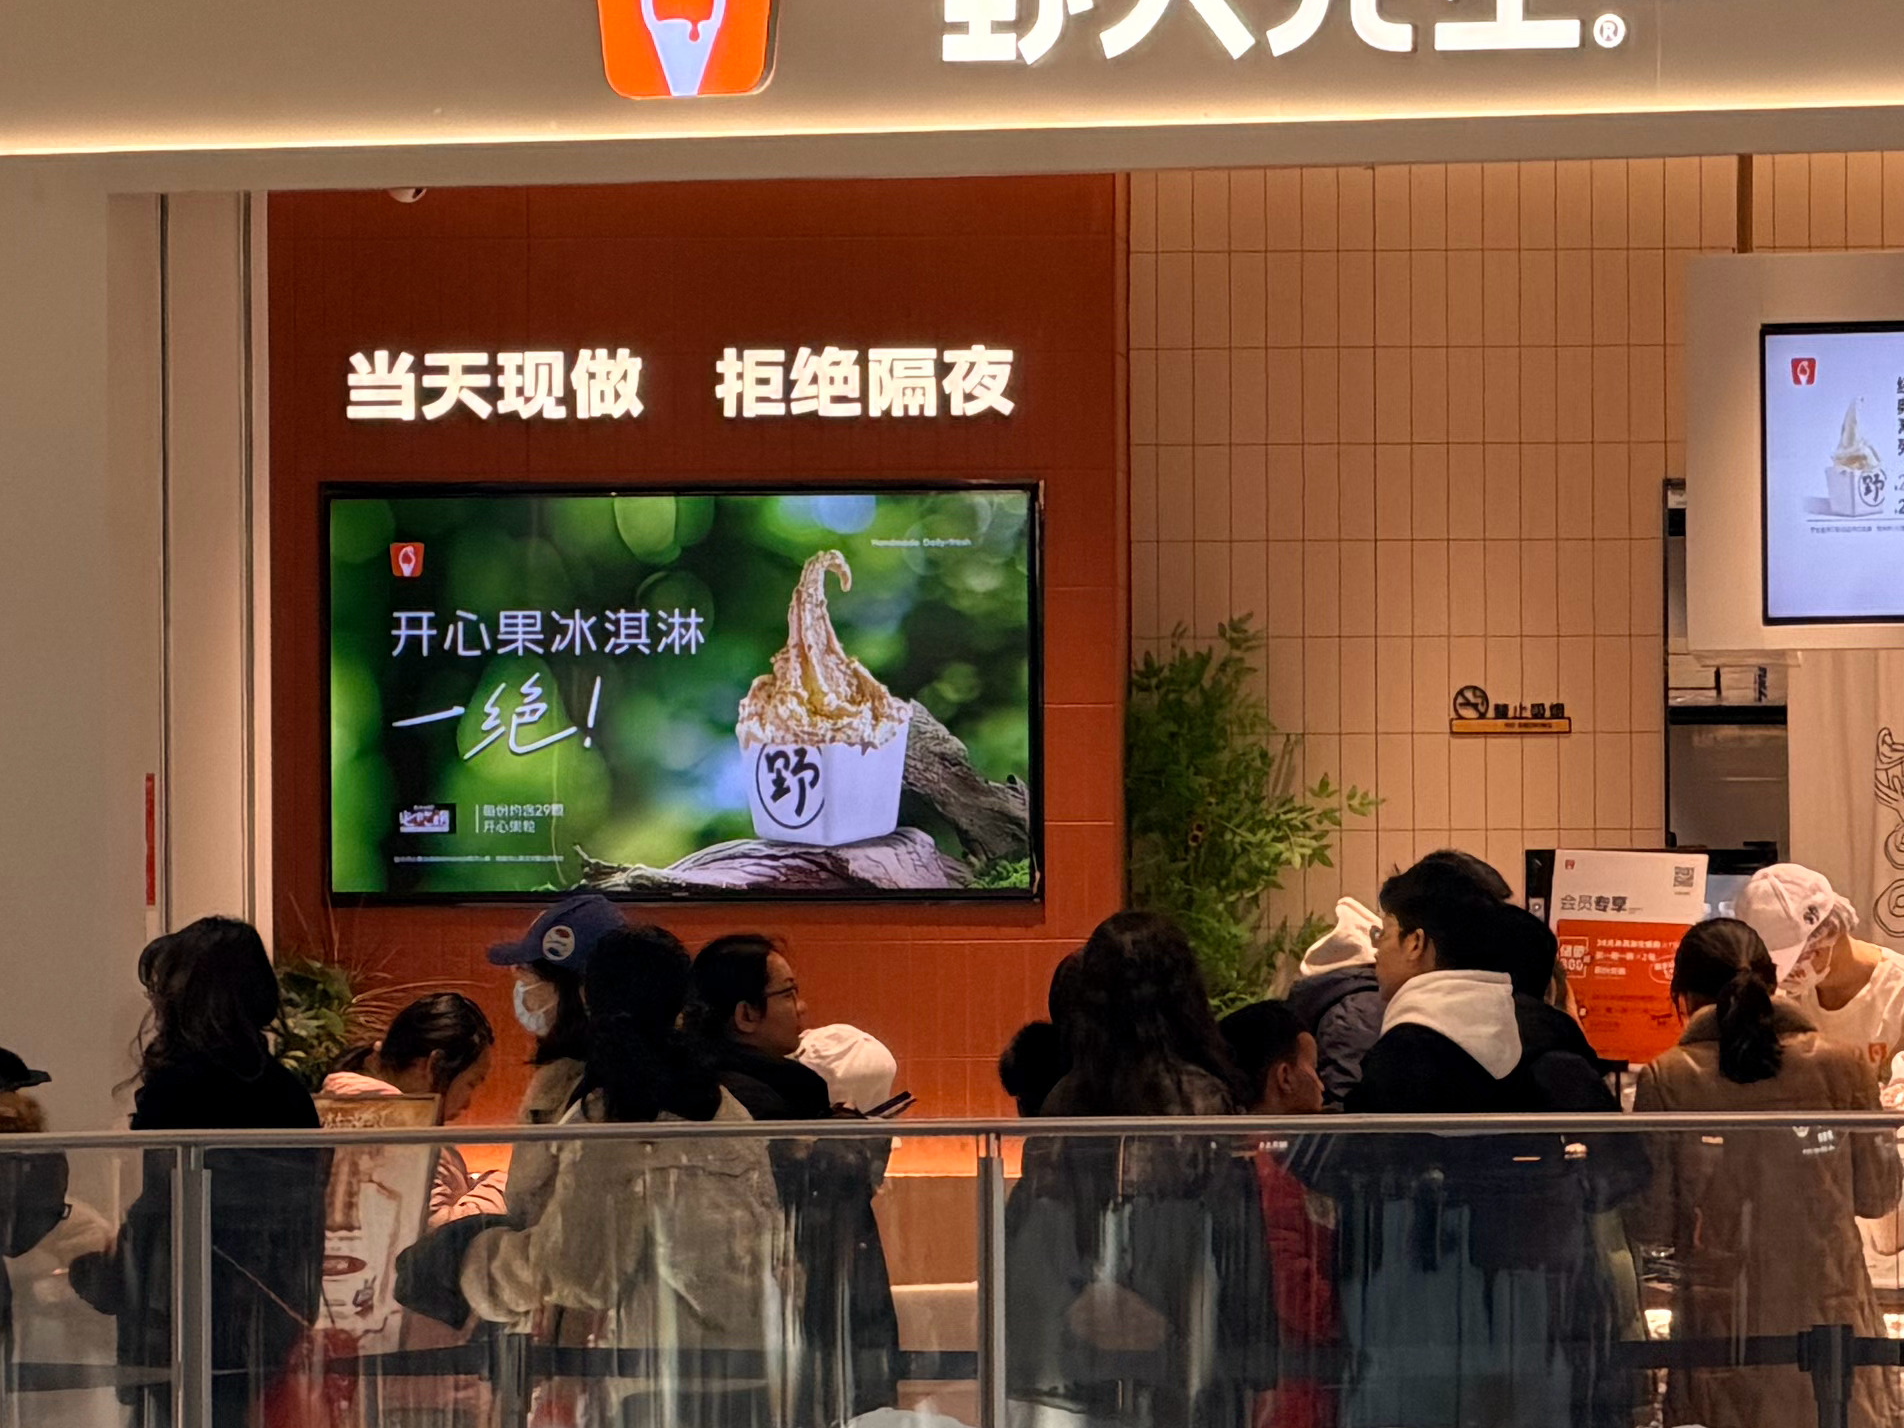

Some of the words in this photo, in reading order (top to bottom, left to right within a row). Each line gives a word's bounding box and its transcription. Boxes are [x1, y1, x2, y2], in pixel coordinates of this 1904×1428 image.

[346, 347, 645, 421] 当天现做
[715, 344, 1016, 419] 拒绝隔夜
[391, 608, 705, 658] 开心果冰淇淋
[392, 672, 602, 761] 一绝!
[765, 744, 820, 817] 野
[1560, 894, 1628, 913] 会员专享
